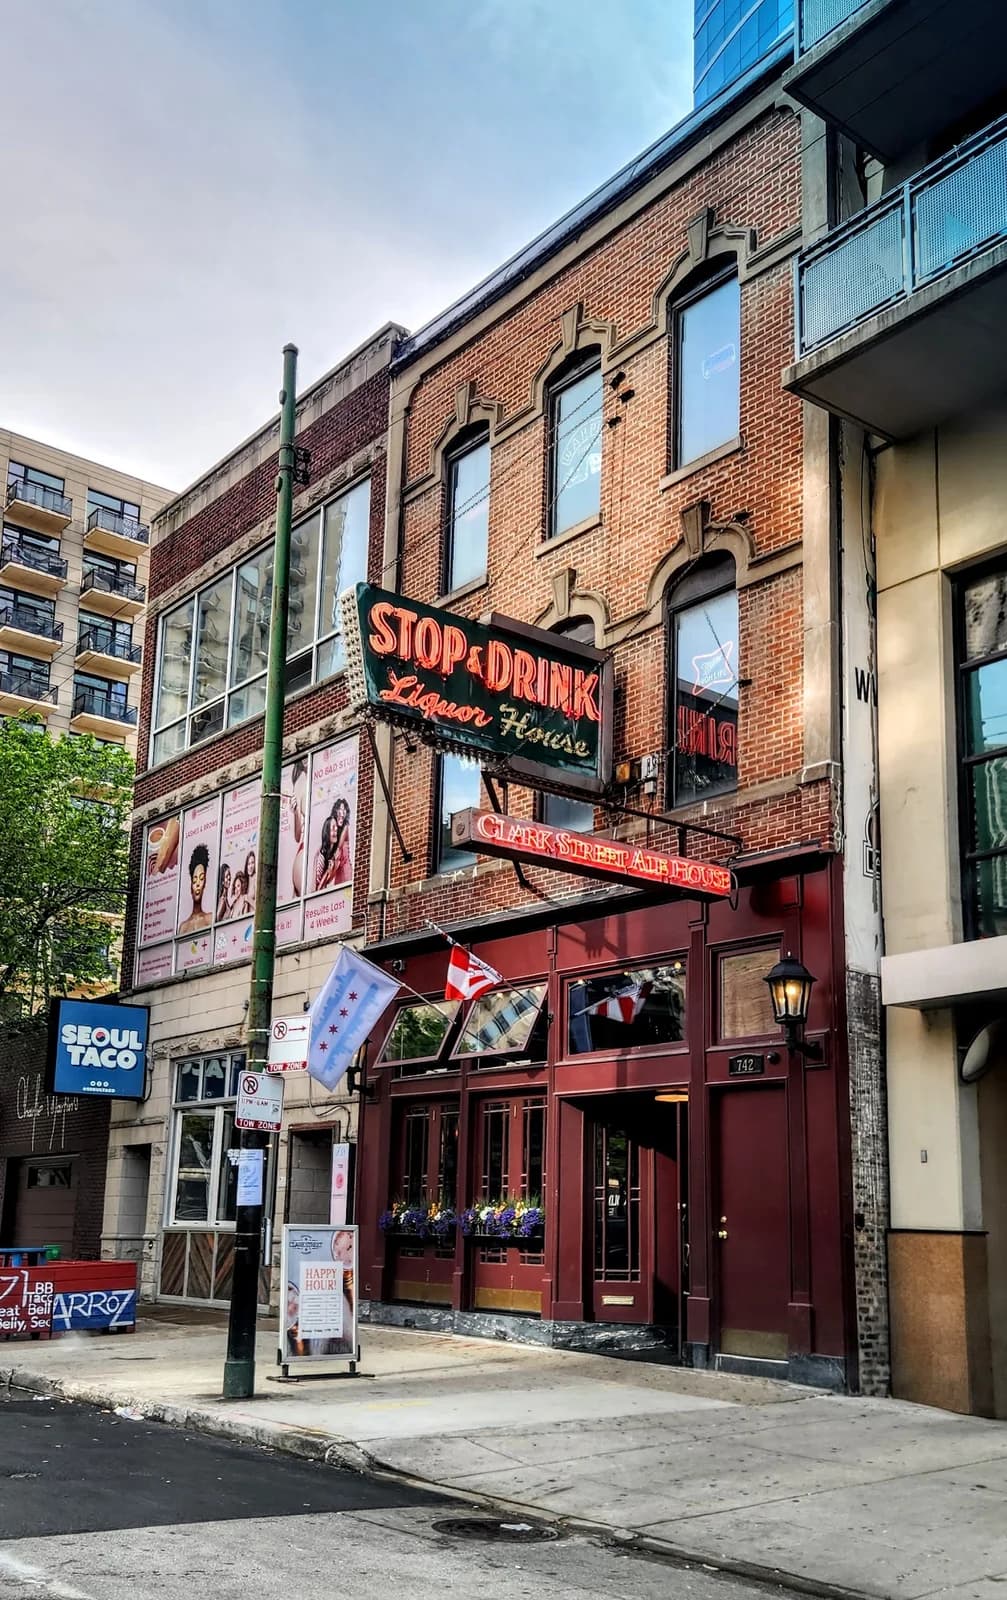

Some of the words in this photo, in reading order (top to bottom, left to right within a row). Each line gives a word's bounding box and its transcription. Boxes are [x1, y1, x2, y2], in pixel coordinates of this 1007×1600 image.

[368, 601, 468, 676] STOP
[466, 645, 484, 679] &
[485, 640, 601, 721] DRINK
[379, 666, 494, 727] Liquor
[499, 703, 591, 757] House
[477, 814, 556, 852] CLARK
[555, 832, 630, 868] STREET
[630, 849, 669, 876] ALE
[669, 859, 731, 889] HOUSE
[305, 906, 329, 919] Results
[331, 900, 345, 912] Last
[317, 914, 339, 929] Weeks
[61, 1024, 143, 1050] SEOUL
[66, 1045, 137, 1070] TACO
[270, 1063, 283, 1072] TOW
[287, 1061, 303, 1071] ZONE
[736, 1058, 754, 1071] 742
[239, 1118, 255, 1128] TOW
[257, 1121, 279, 1131] ZONE
[305, 1268, 337, 1279] HAPPY
[305, 1279, 337, 1290] HOUR!
[52, 1289, 135, 1329] ARROZ
